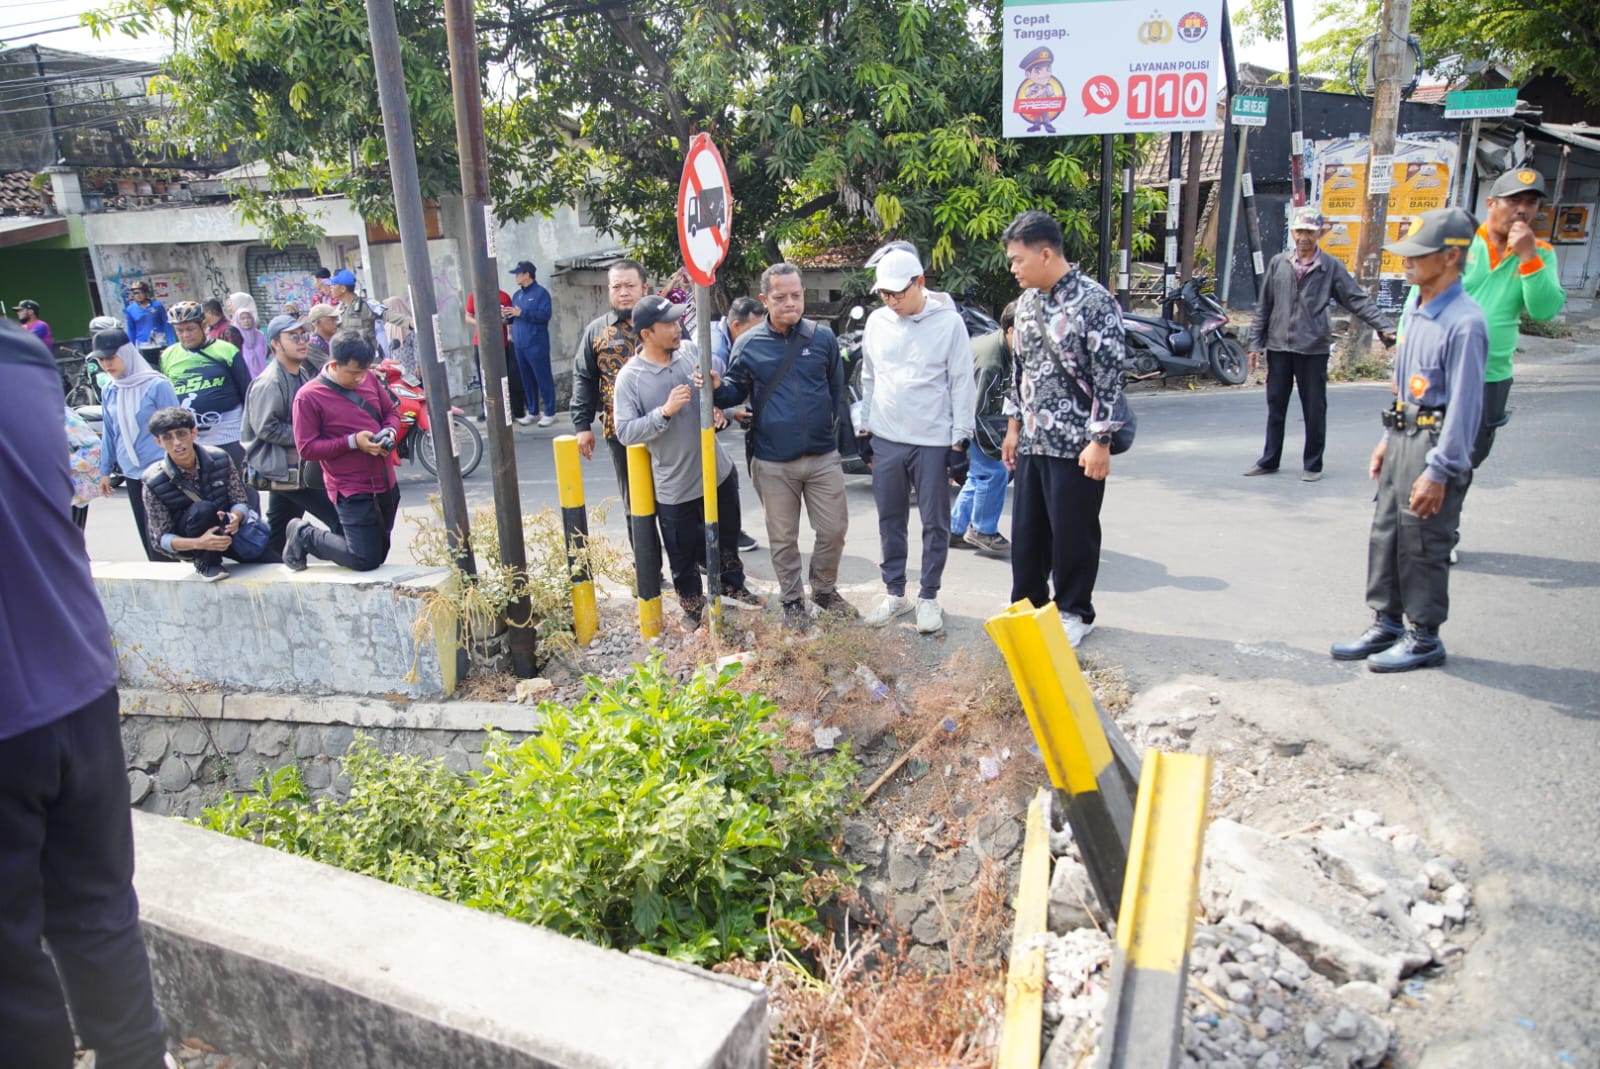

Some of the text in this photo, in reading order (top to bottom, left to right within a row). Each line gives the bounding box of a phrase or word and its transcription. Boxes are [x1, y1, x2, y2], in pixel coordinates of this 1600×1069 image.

[1013, 14, 1050, 26] Cepat
[1013, 28, 1070, 40] Tanggap.
[1129, 60, 1210, 72] LAYANAN POLISI
[1131, 78, 1205, 114] 110
[1473, 107, 1510, 115] NASIONAL
[1328, 201, 1356, 209] BARU
